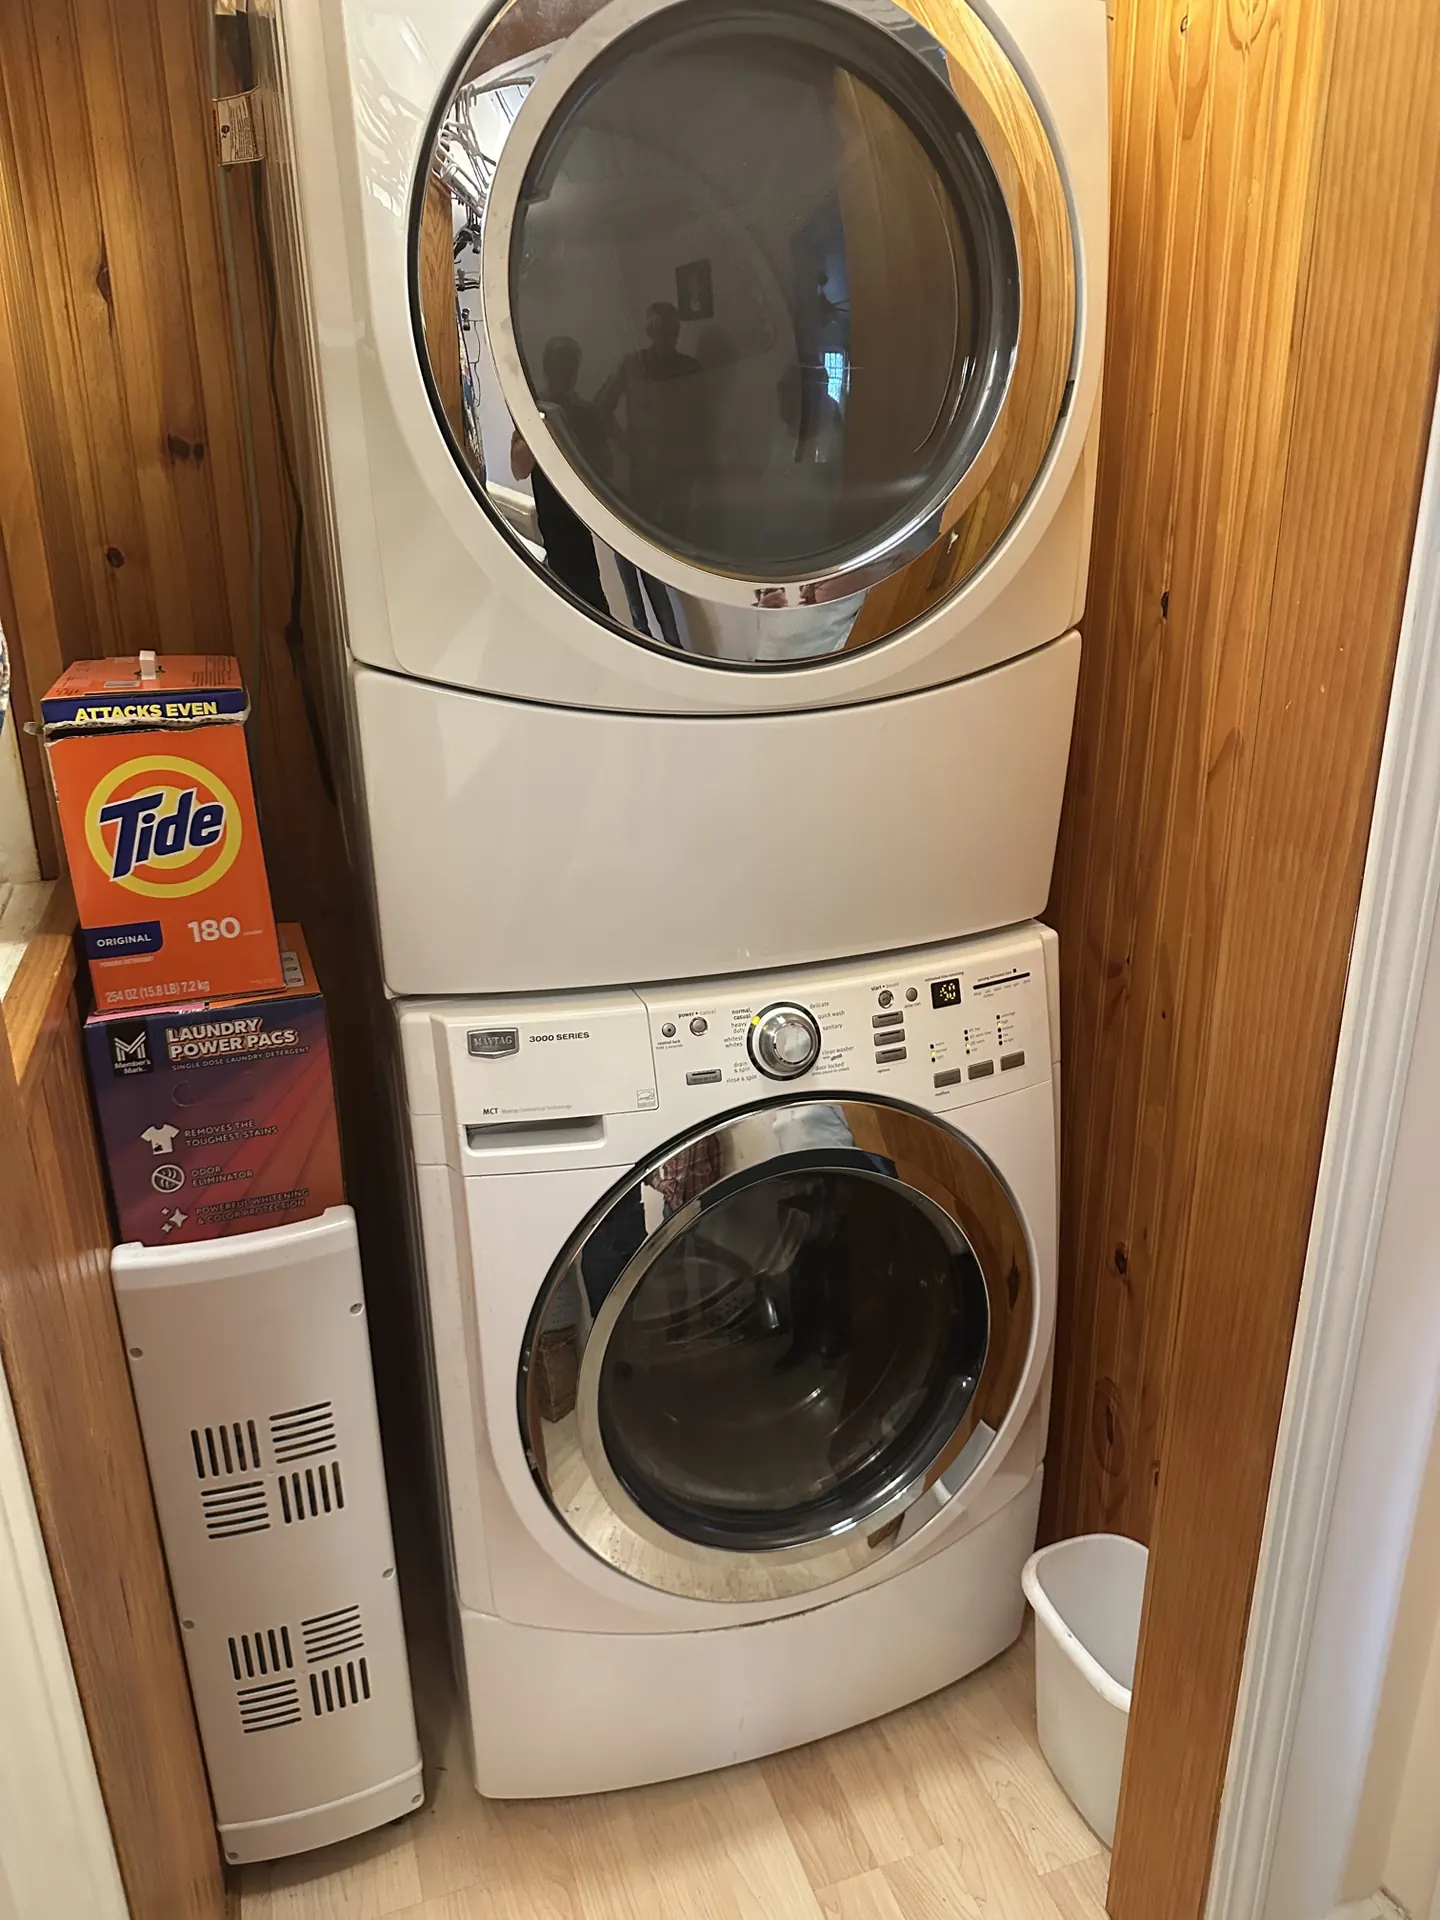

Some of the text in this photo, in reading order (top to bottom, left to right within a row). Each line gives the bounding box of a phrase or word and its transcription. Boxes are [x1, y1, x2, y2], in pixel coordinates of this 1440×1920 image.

[75, 702, 218, 721] ATTACKS EVEN
[99, 788, 226, 881] Tide
[188, 916, 241, 942] 180
[96, 933, 152, 947] ORIGINAL
[105, 980, 210, 1003] 254 OZ (15.8 LB) 7.2 kg
[809, 1001, 829, 1009] delicate
[817, 1012, 831, 1020] quick
[167, 1017, 262, 1042] LAUNDRY
[822, 1023, 843, 1031] sanitary
[170, 1030, 298, 1060] POWER PACS
[473, 1036, 513, 1048] MAYTAG
[529, 1031, 590, 1043] 3000 SERIES
[114, 1060, 151, 1069] Member's
[172, 1047, 310, 1071] SINGLE DOSE LAUNDRY DETERGENT
[483, 1107, 499, 1115] MCT
[184, 1120, 255, 1137] REMOVES THE
[186, 1126, 278, 1147] TOUGHEST STAINS
[191, 1165, 222, 1177] ODOR
[192, 1170, 254, 1187] ELIMINATOR
[196, 1188, 309, 1215] POWERFUL WHITENING
[207, 1208, 241, 1223] COLOR
[242, 1200, 306, 1216] PROTECTION
